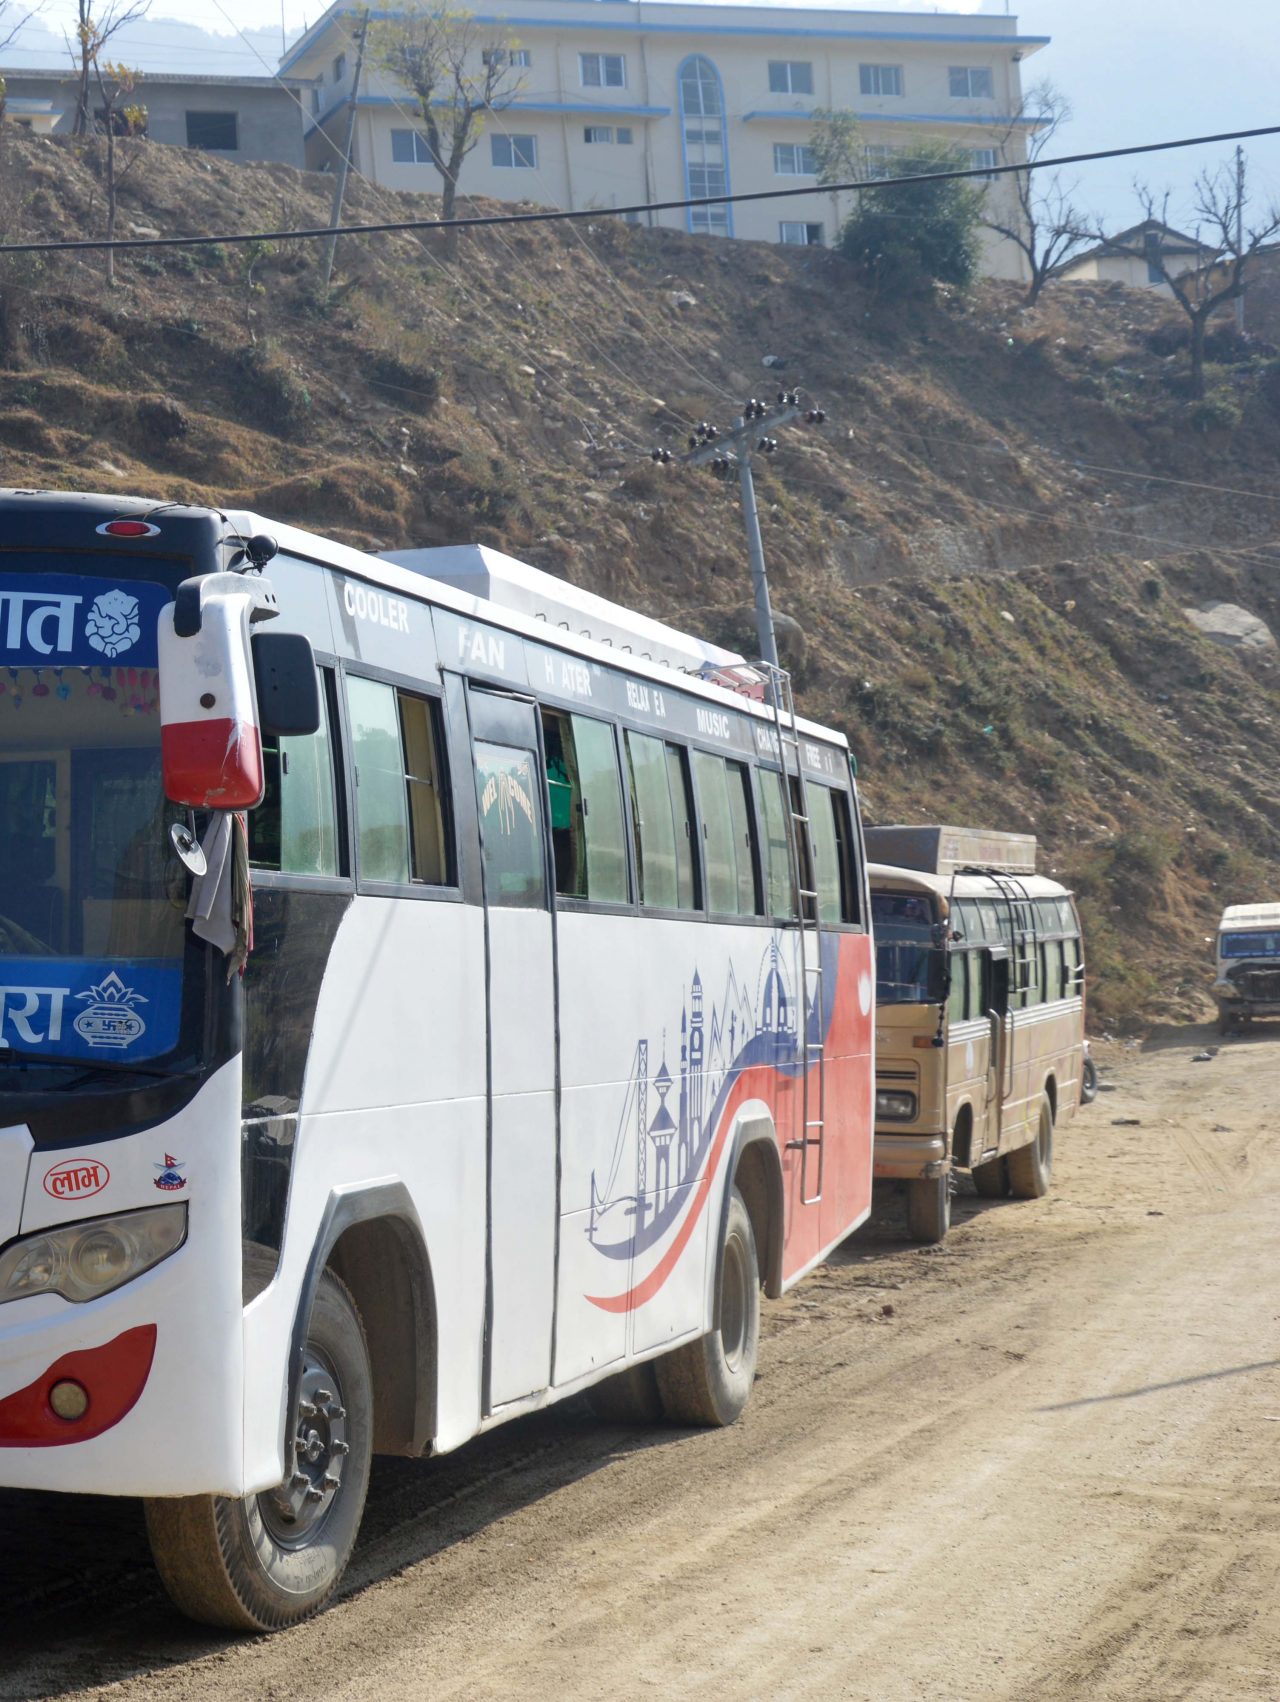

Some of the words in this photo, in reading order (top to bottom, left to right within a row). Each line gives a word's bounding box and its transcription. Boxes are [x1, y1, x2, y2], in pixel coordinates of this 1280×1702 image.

[344, 582, 410, 634] COOLER
[458, 625, 505, 670] FAN
[626, 680, 650, 712] RELAX
[696, 708, 730, 740] MUSIC
[805, 743, 822, 769] FREE
[49, 1165, 100, 1196] लाभ
